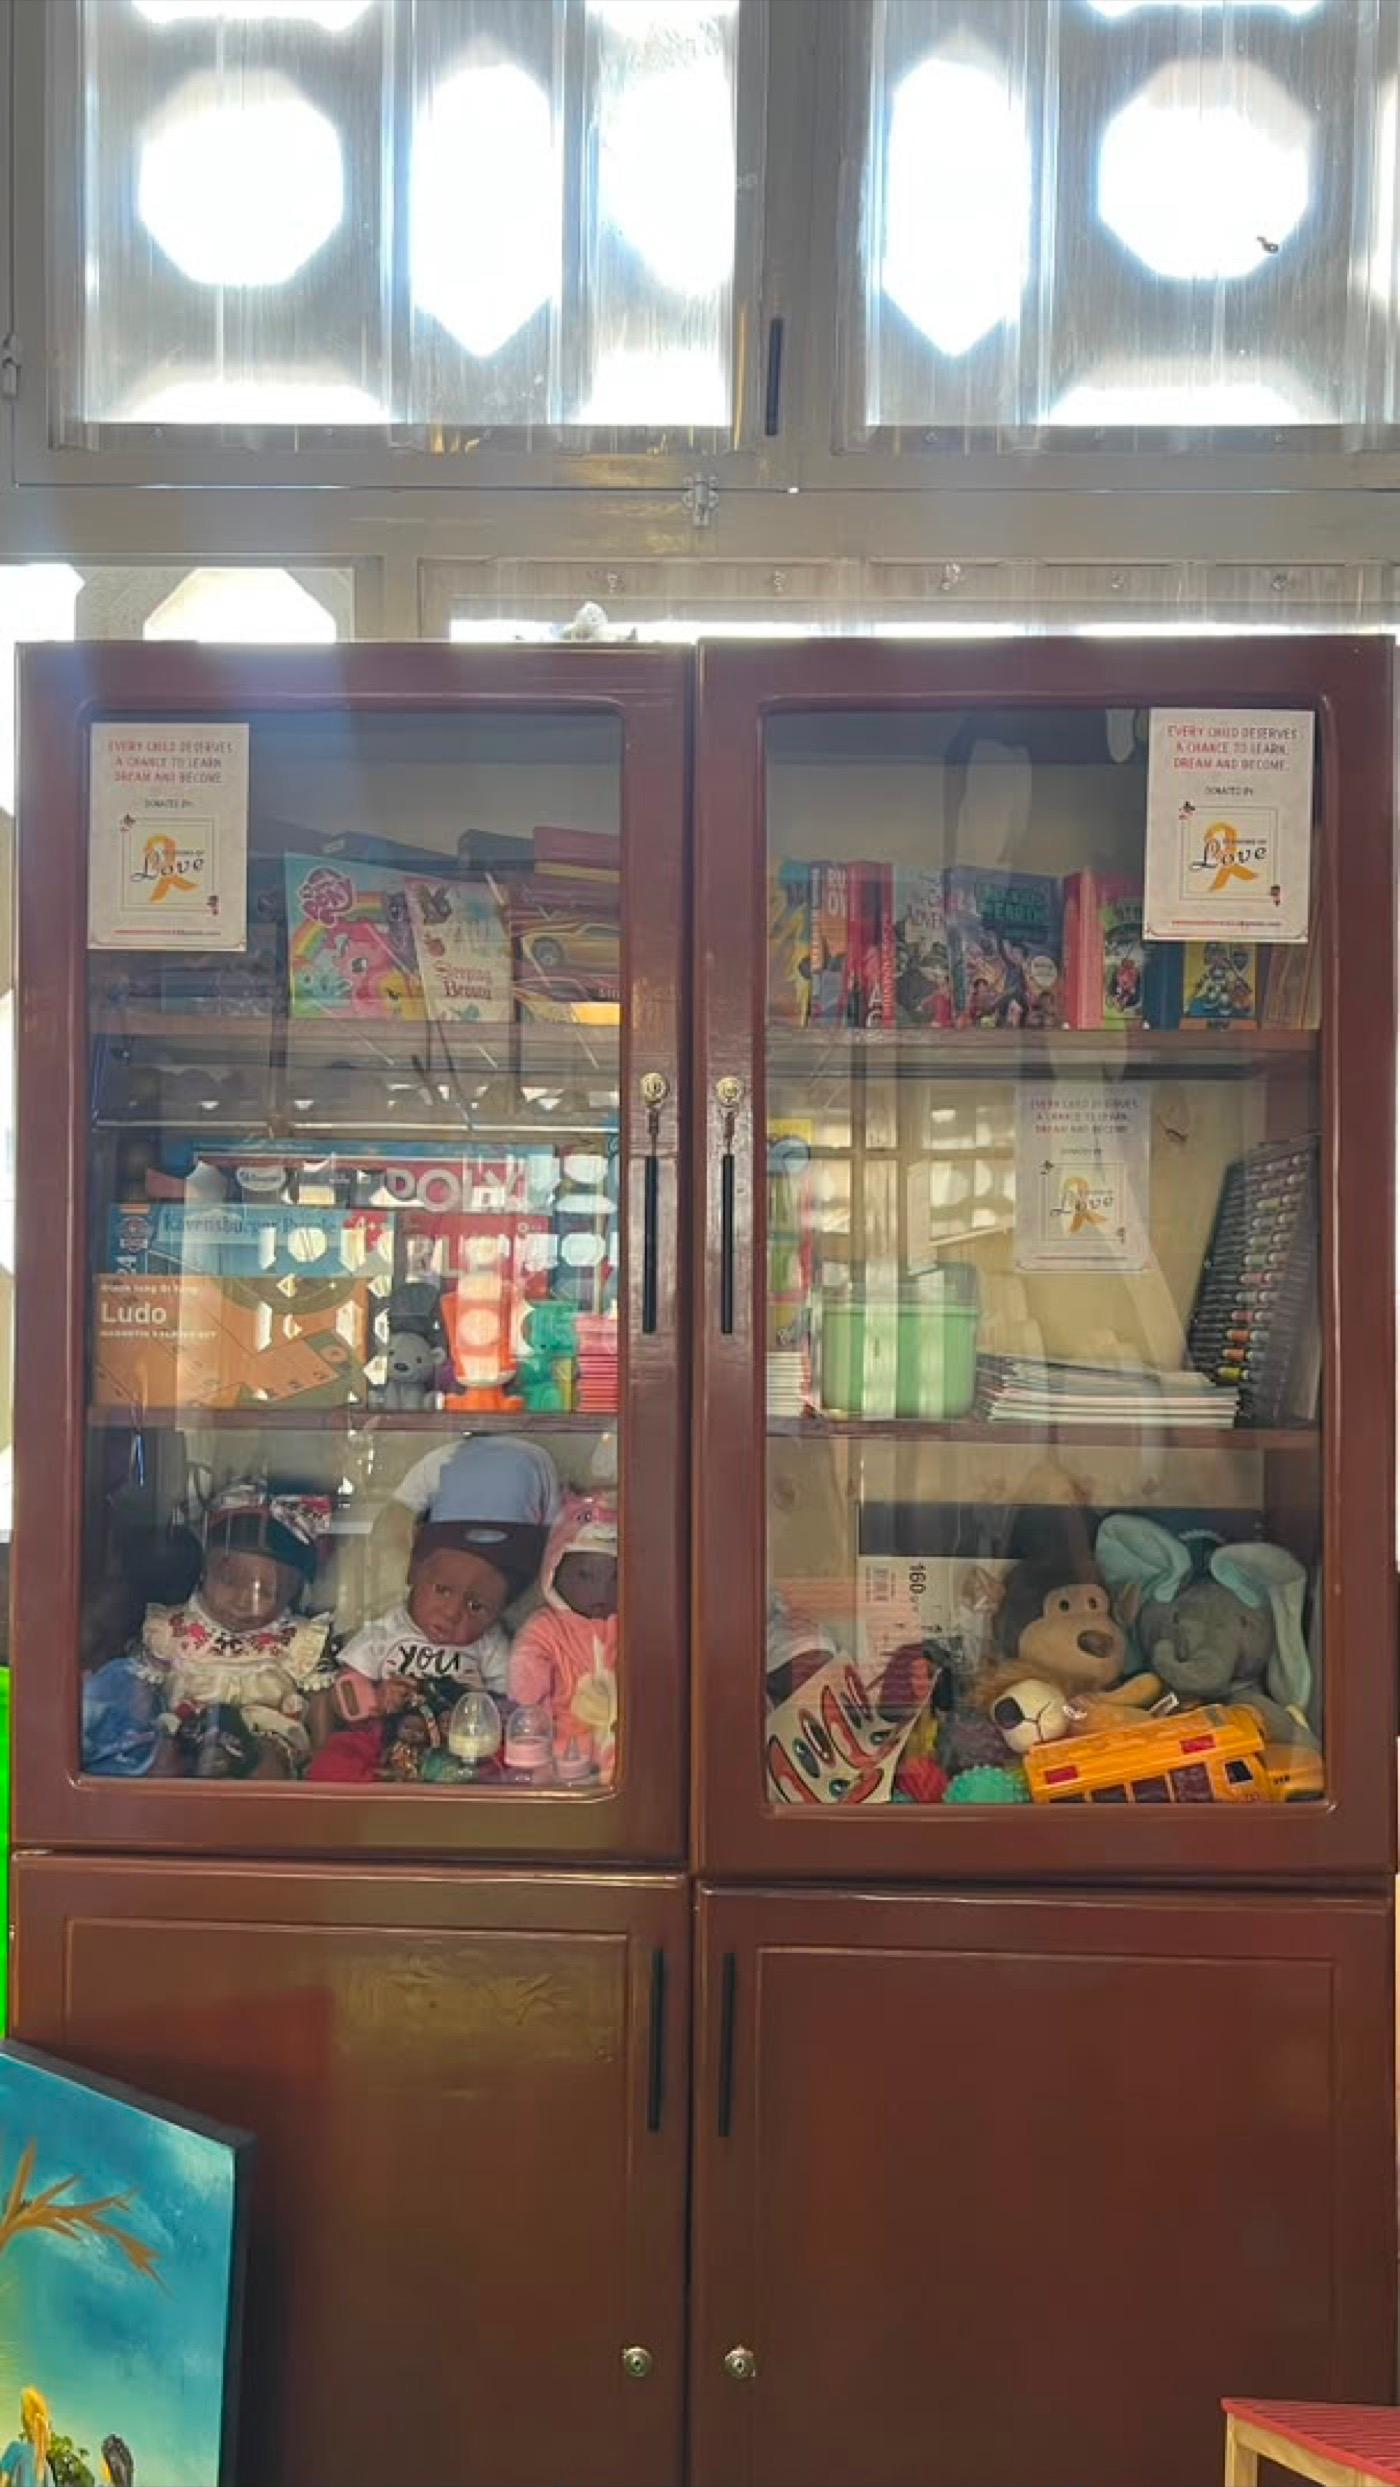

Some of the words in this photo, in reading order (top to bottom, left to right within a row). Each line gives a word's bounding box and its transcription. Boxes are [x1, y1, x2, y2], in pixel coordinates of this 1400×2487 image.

[1168, 725, 1203, 738] EVERY
[1208, 726, 1239, 738] CHILD
[1241, 727, 1297, 739] DESERVES
[107, 741, 142, 752] EVERY
[1176, 743, 1183, 754] A
[1186, 743, 1228, 754] CHANCE
[1233, 743, 1246, 754] TO
[1173, 758, 1213, 770] DREAM
[1215, 759, 1237, 770] AND
[1189, 840, 1267, 871] Love
[130, 850, 205, 882] Love
[102, 1302, 167, 1324] Ludo
[908, 1561, 926, 1594] 160
